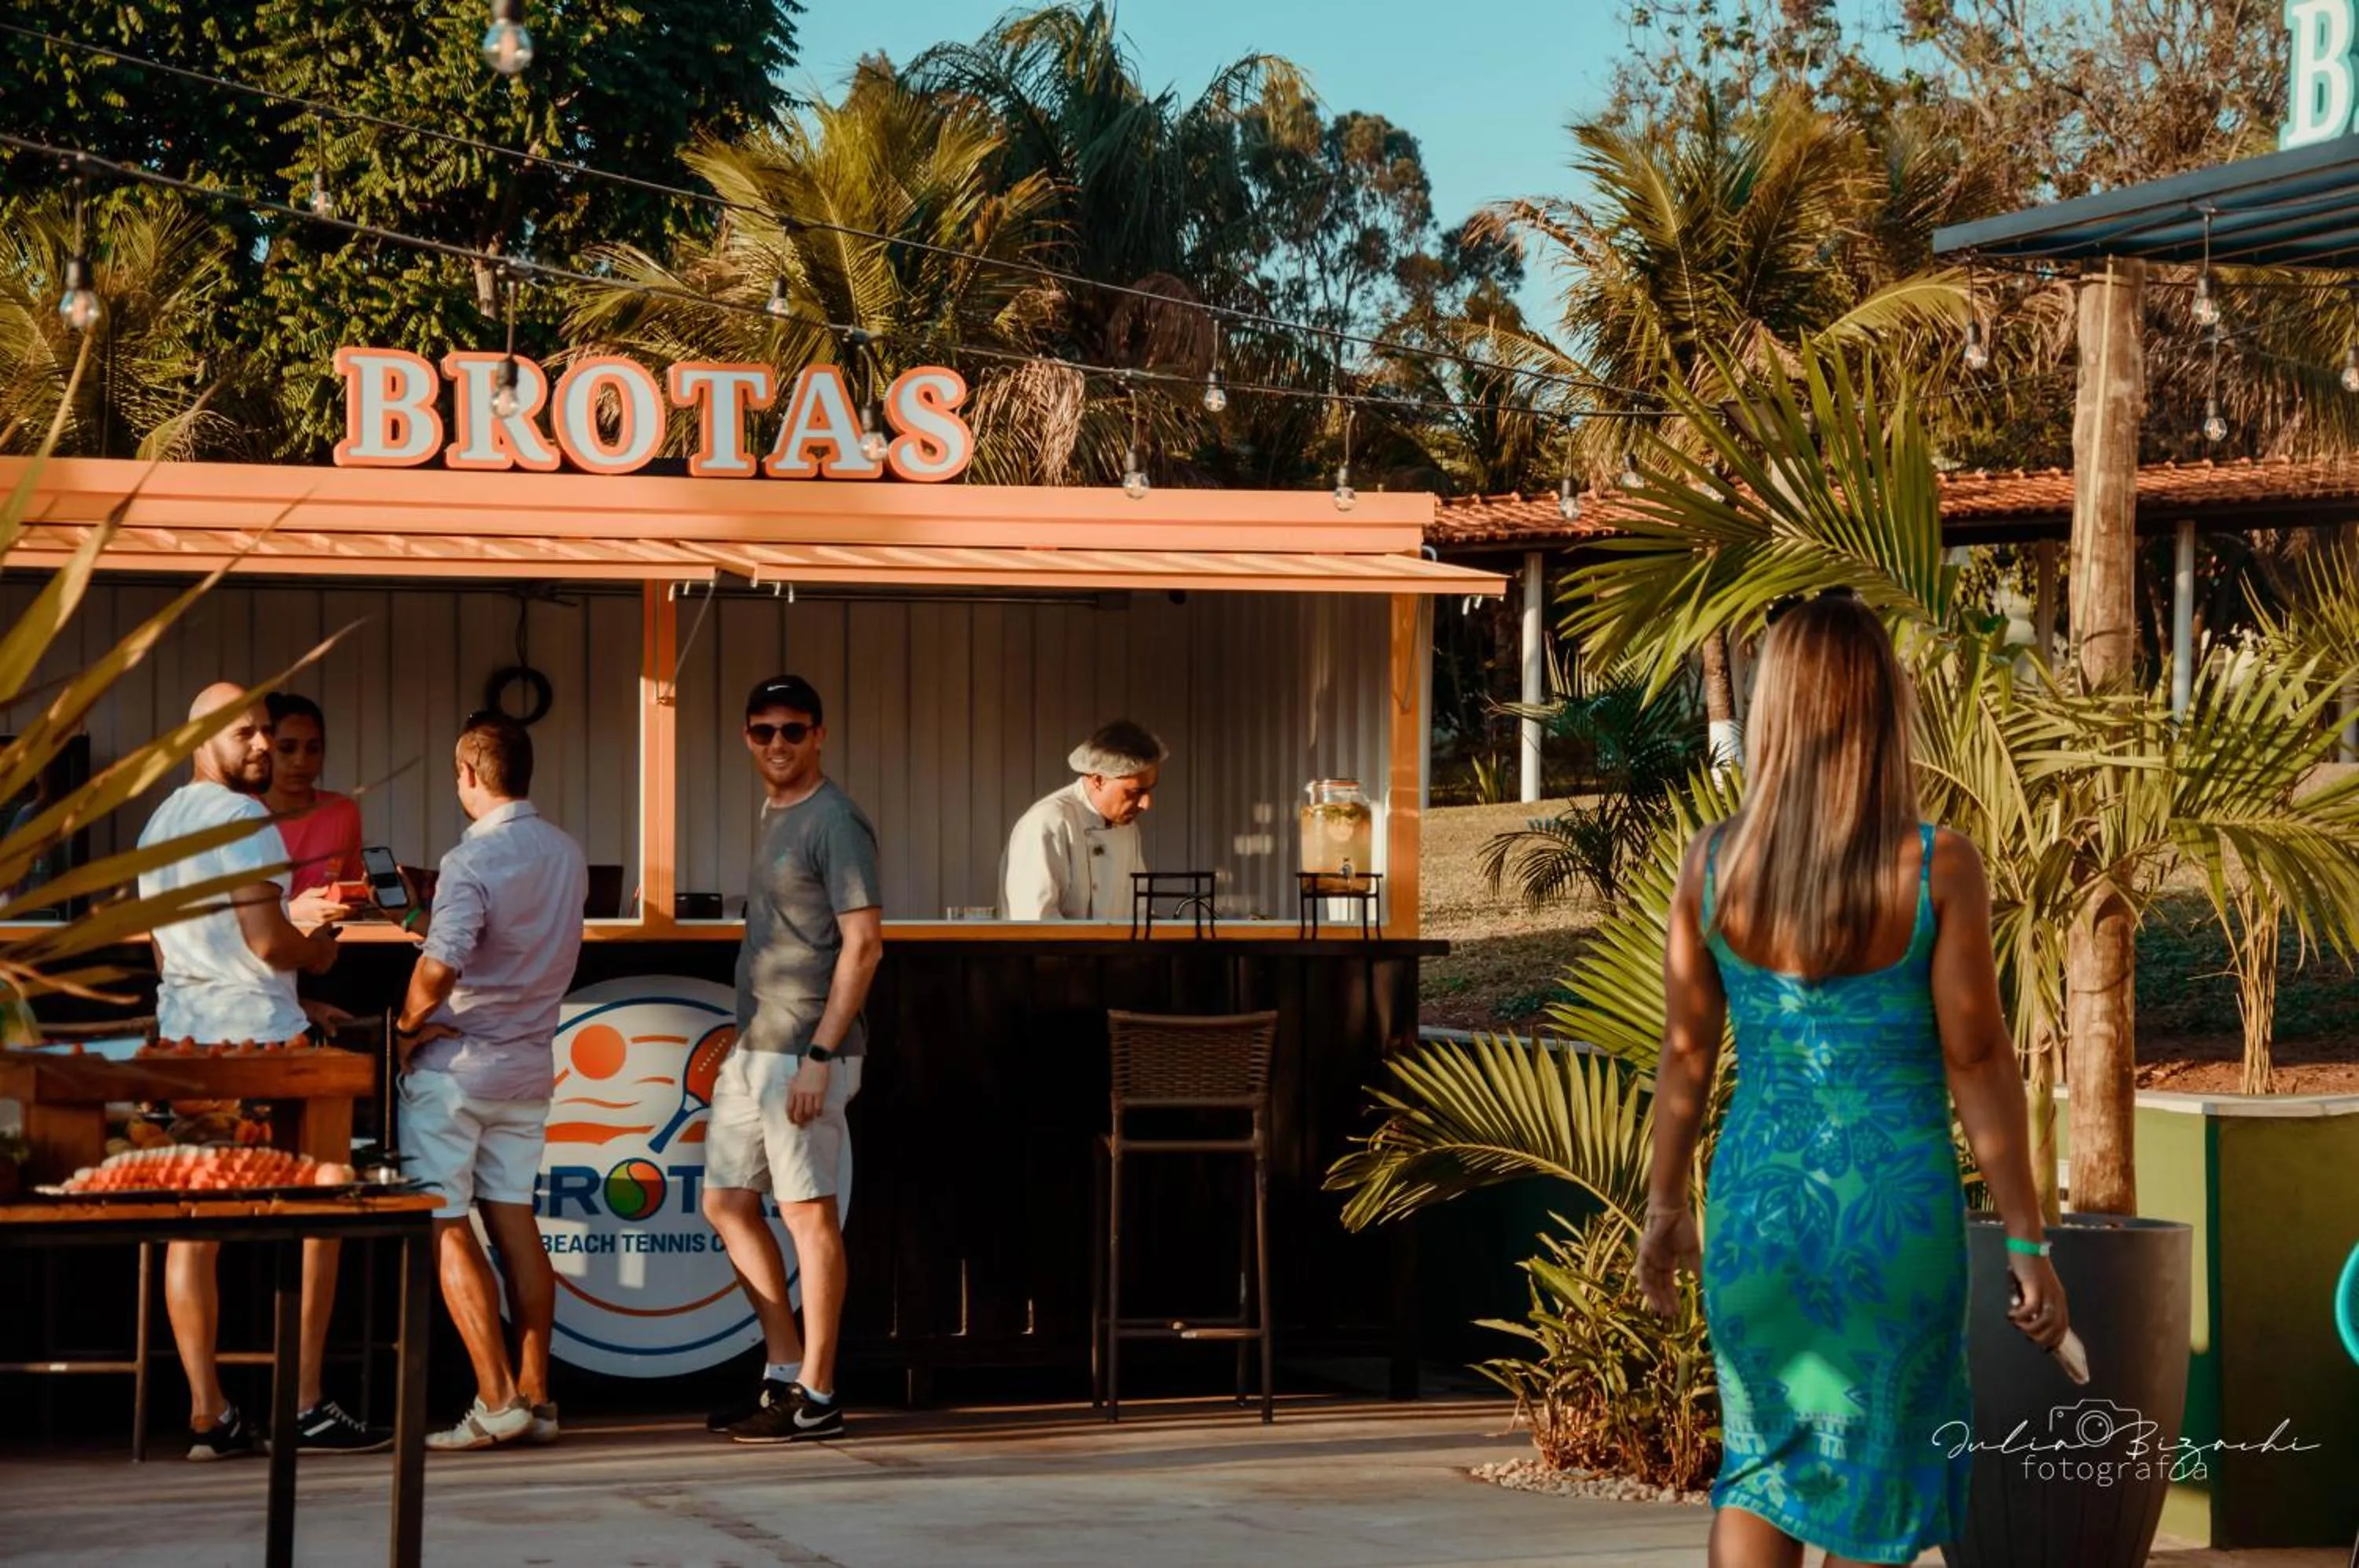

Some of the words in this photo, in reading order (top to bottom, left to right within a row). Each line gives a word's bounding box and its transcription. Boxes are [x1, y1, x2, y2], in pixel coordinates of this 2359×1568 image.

[2278, 0, 2359, 152] B
[333, 346, 973, 482] BROTAS
[539, 1234, 616, 1253] BEACH
[621, 1233, 706, 1253] TENNIS
